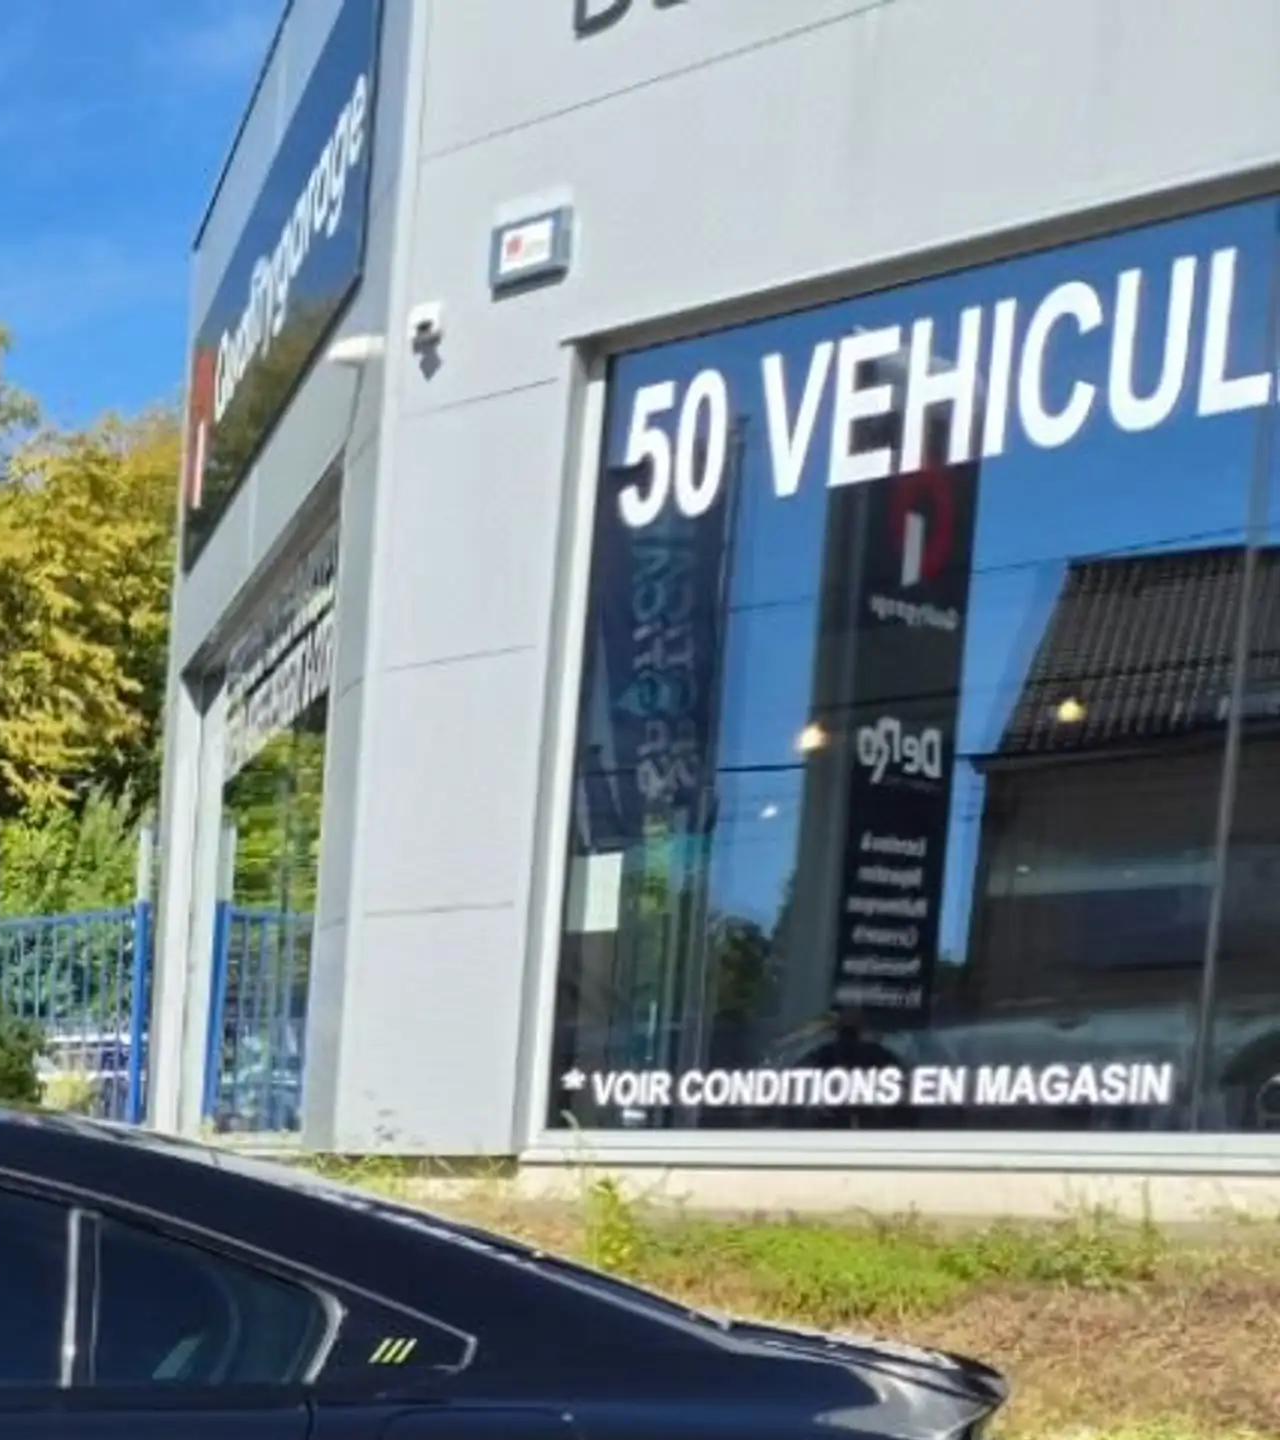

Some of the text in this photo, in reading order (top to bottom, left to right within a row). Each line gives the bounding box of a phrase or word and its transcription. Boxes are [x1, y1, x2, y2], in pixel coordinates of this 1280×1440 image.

[617, 368, 728, 528] 50
[593, 1071, 670, 1107] VOIR
[678, 1068, 902, 1106] CONDITIONS
[911, 1068, 965, 1105] EN
[975, 1063, 1172, 1105] MAGASIN
